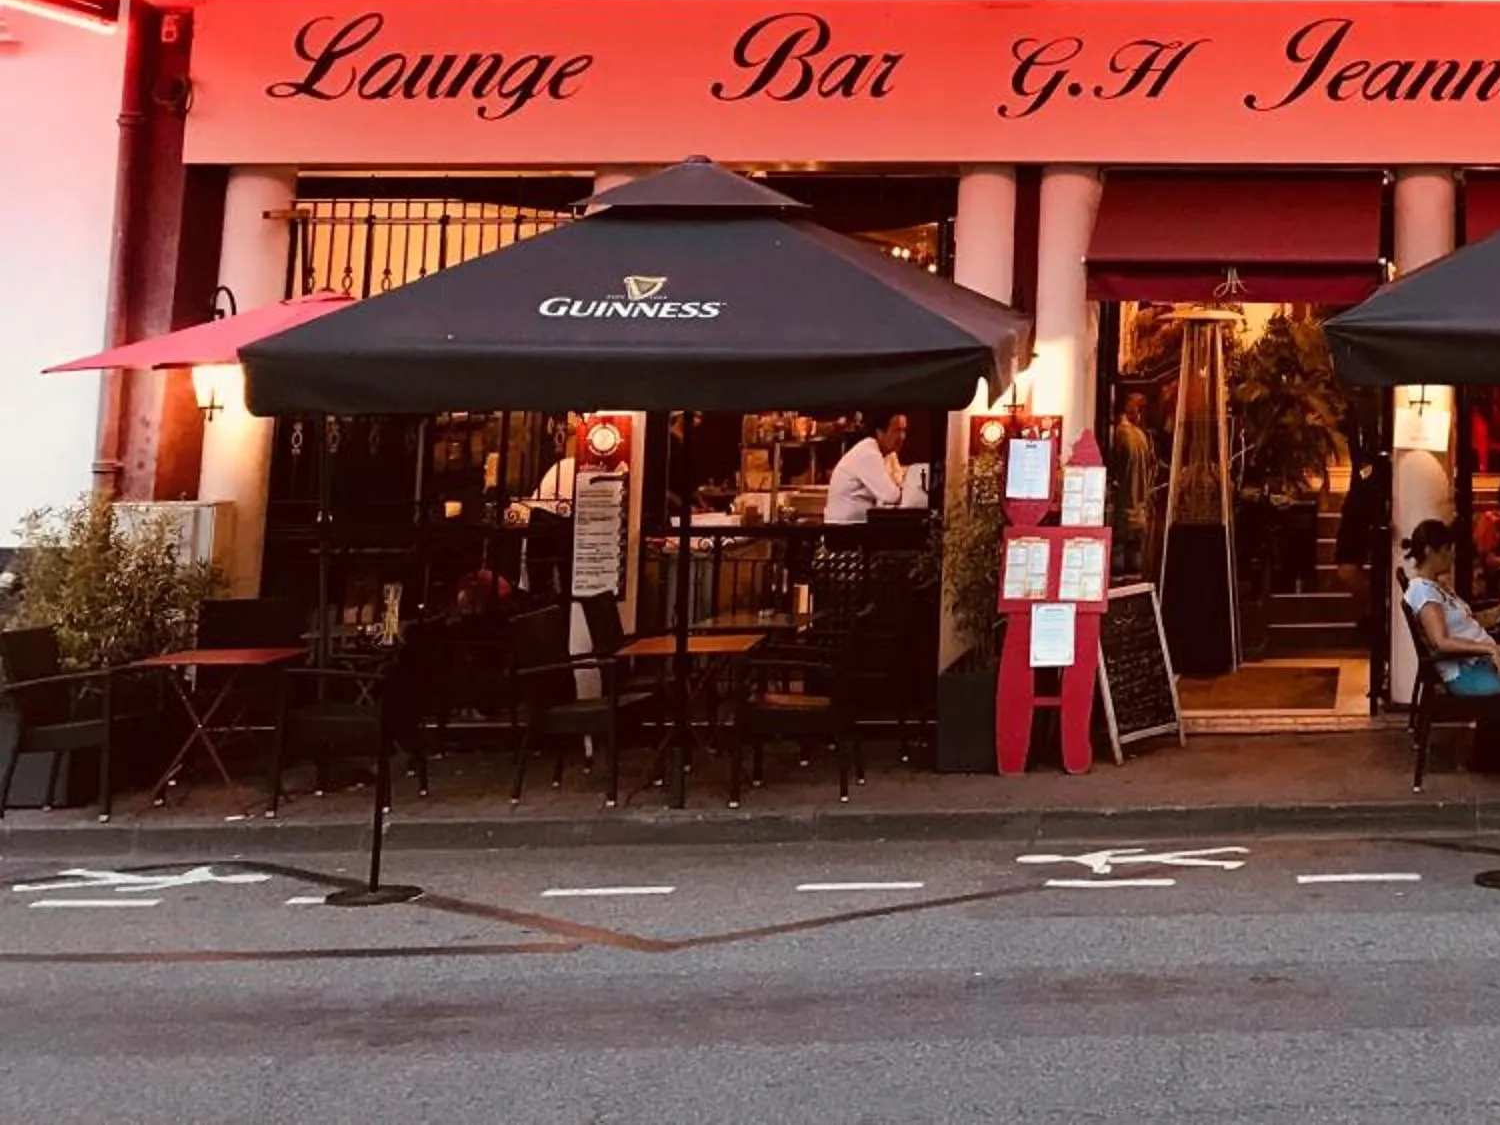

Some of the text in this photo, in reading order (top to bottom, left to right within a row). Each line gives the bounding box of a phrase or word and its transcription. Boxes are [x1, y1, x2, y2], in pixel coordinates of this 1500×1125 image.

[266, 12, 594, 121] Lounge
[710, 12, 905, 103] Bar
[997, 36, 1211, 118] G.H
[538, 296, 721, 318] GUINNESS
